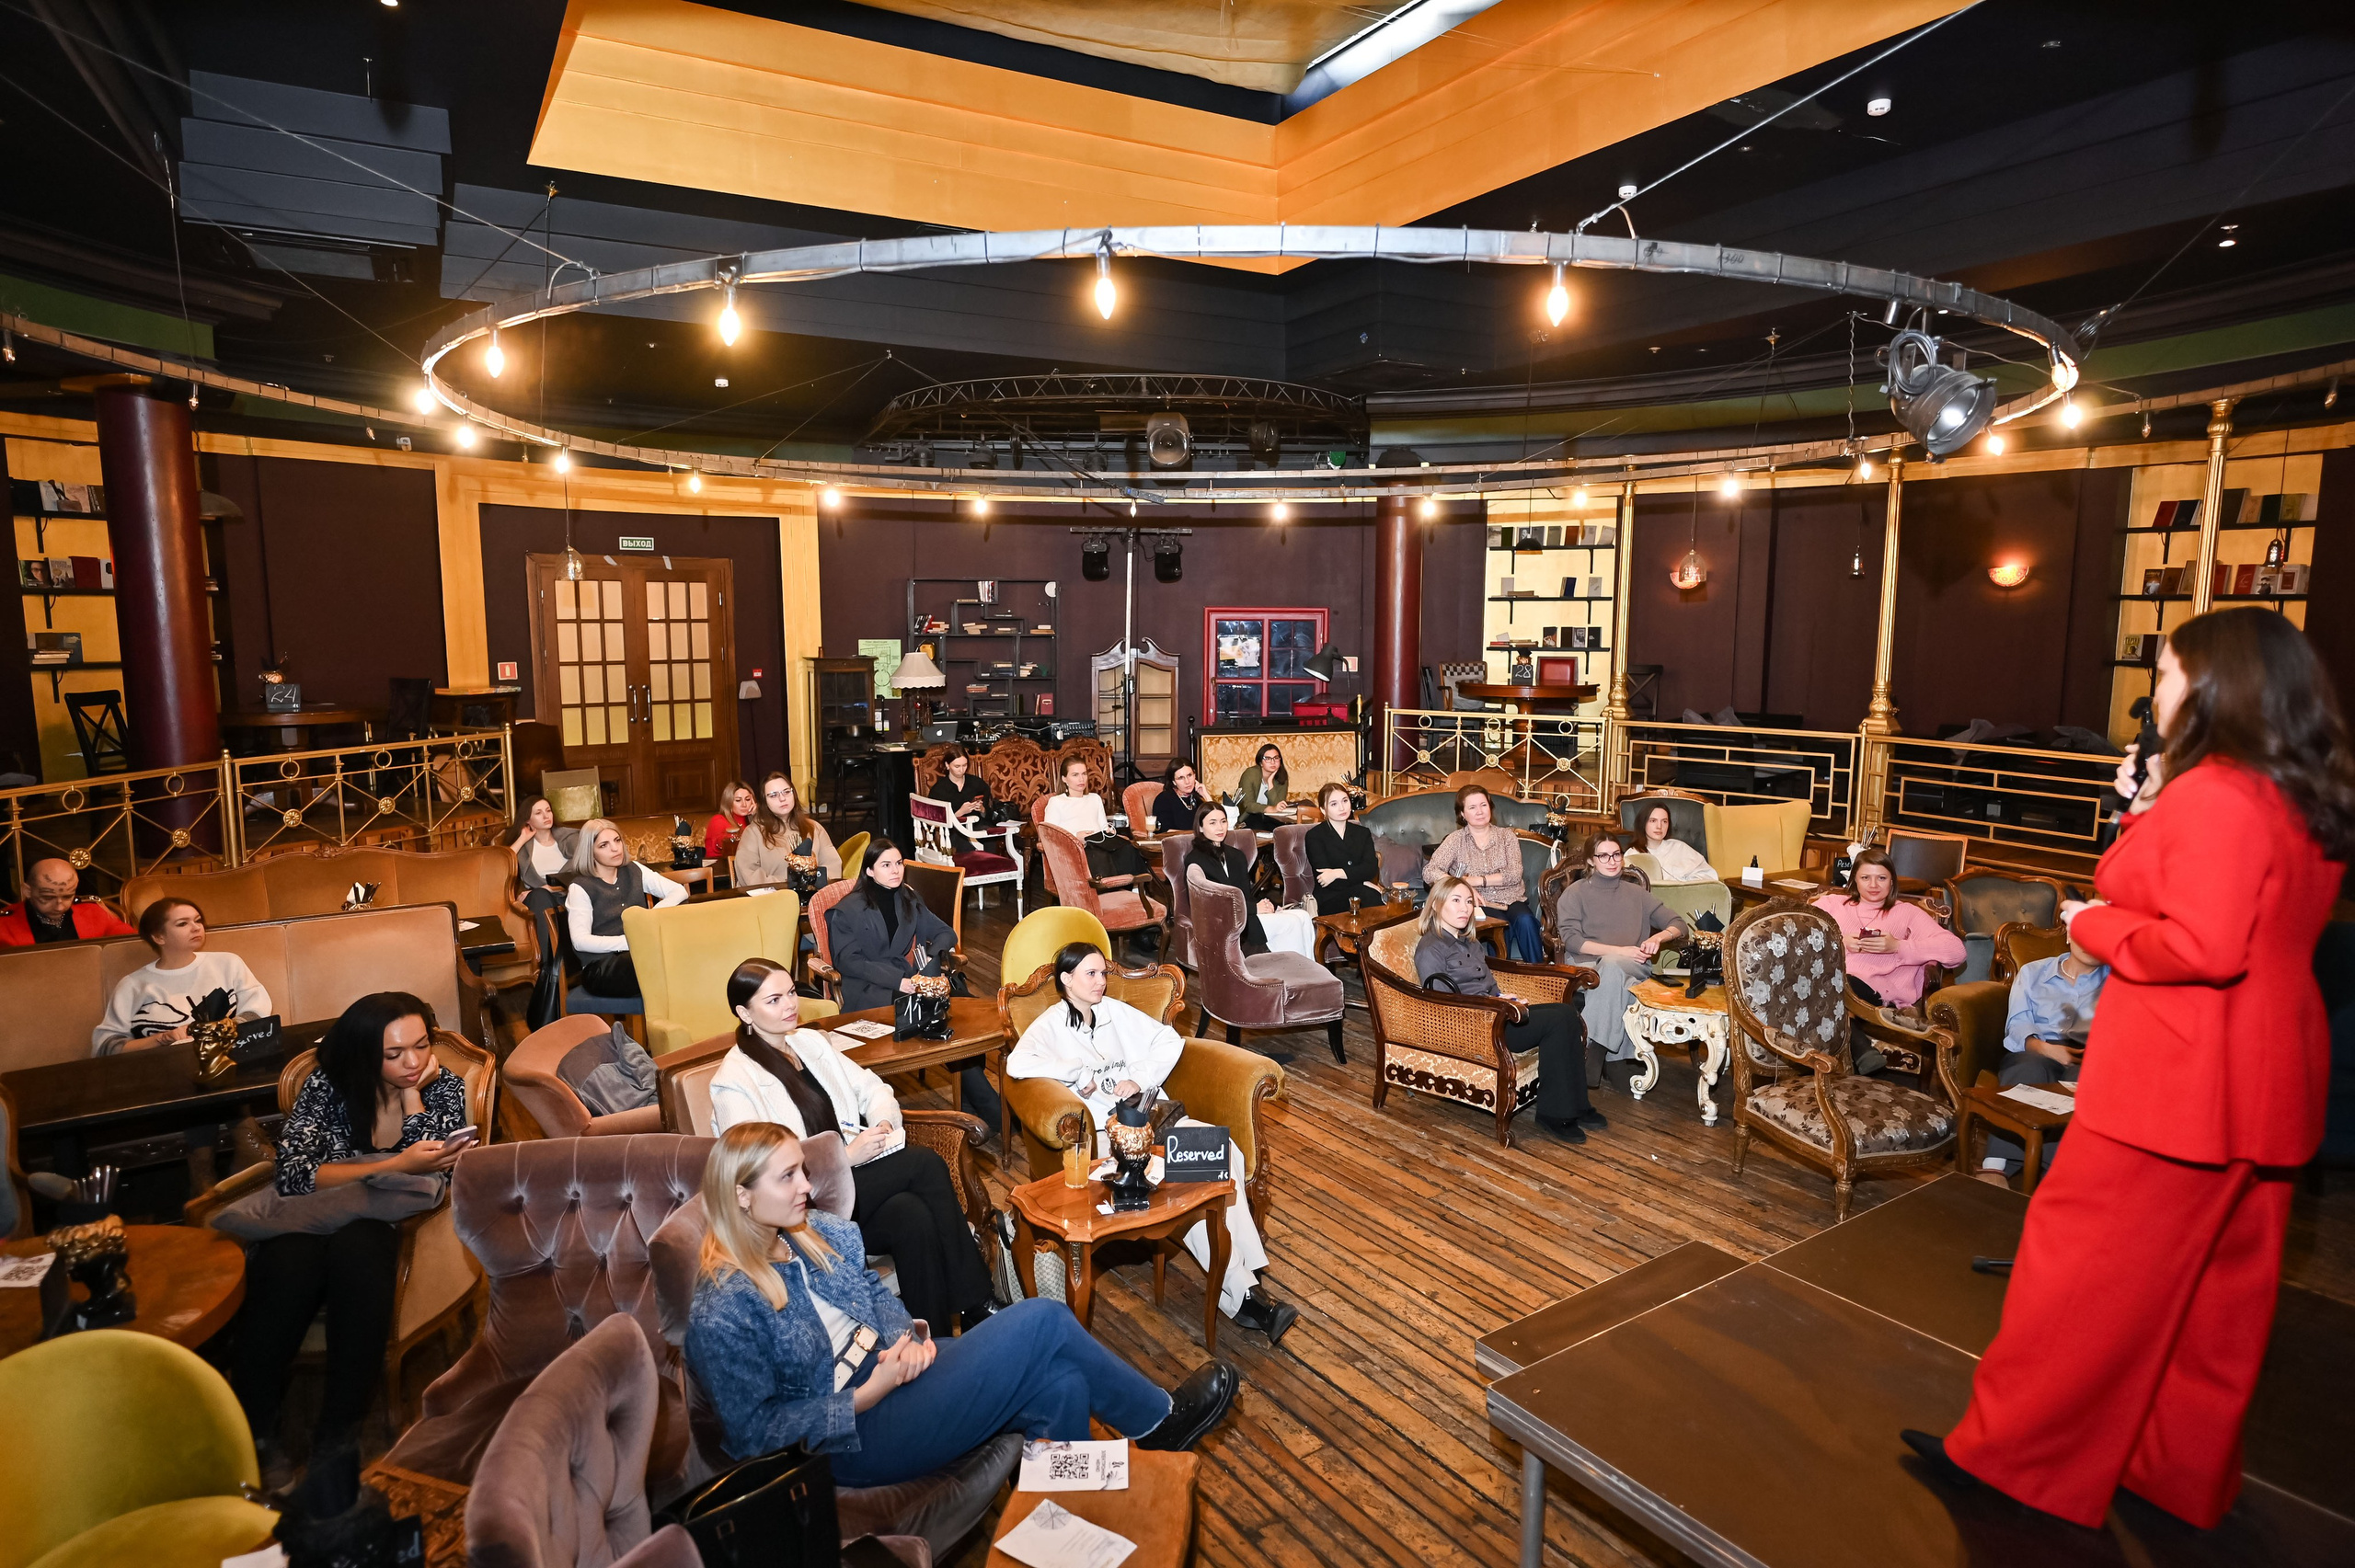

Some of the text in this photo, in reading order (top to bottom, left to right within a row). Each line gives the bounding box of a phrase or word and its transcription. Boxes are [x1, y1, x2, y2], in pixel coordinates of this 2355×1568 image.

[622, 540, 652, 548] ВЫХОД
[1515, 664, 1533, 679] 28
[270, 684, 297, 703] 24
[903, 995, 922, 1024] 11
[1166, 1135, 1225, 1164] Reserved
